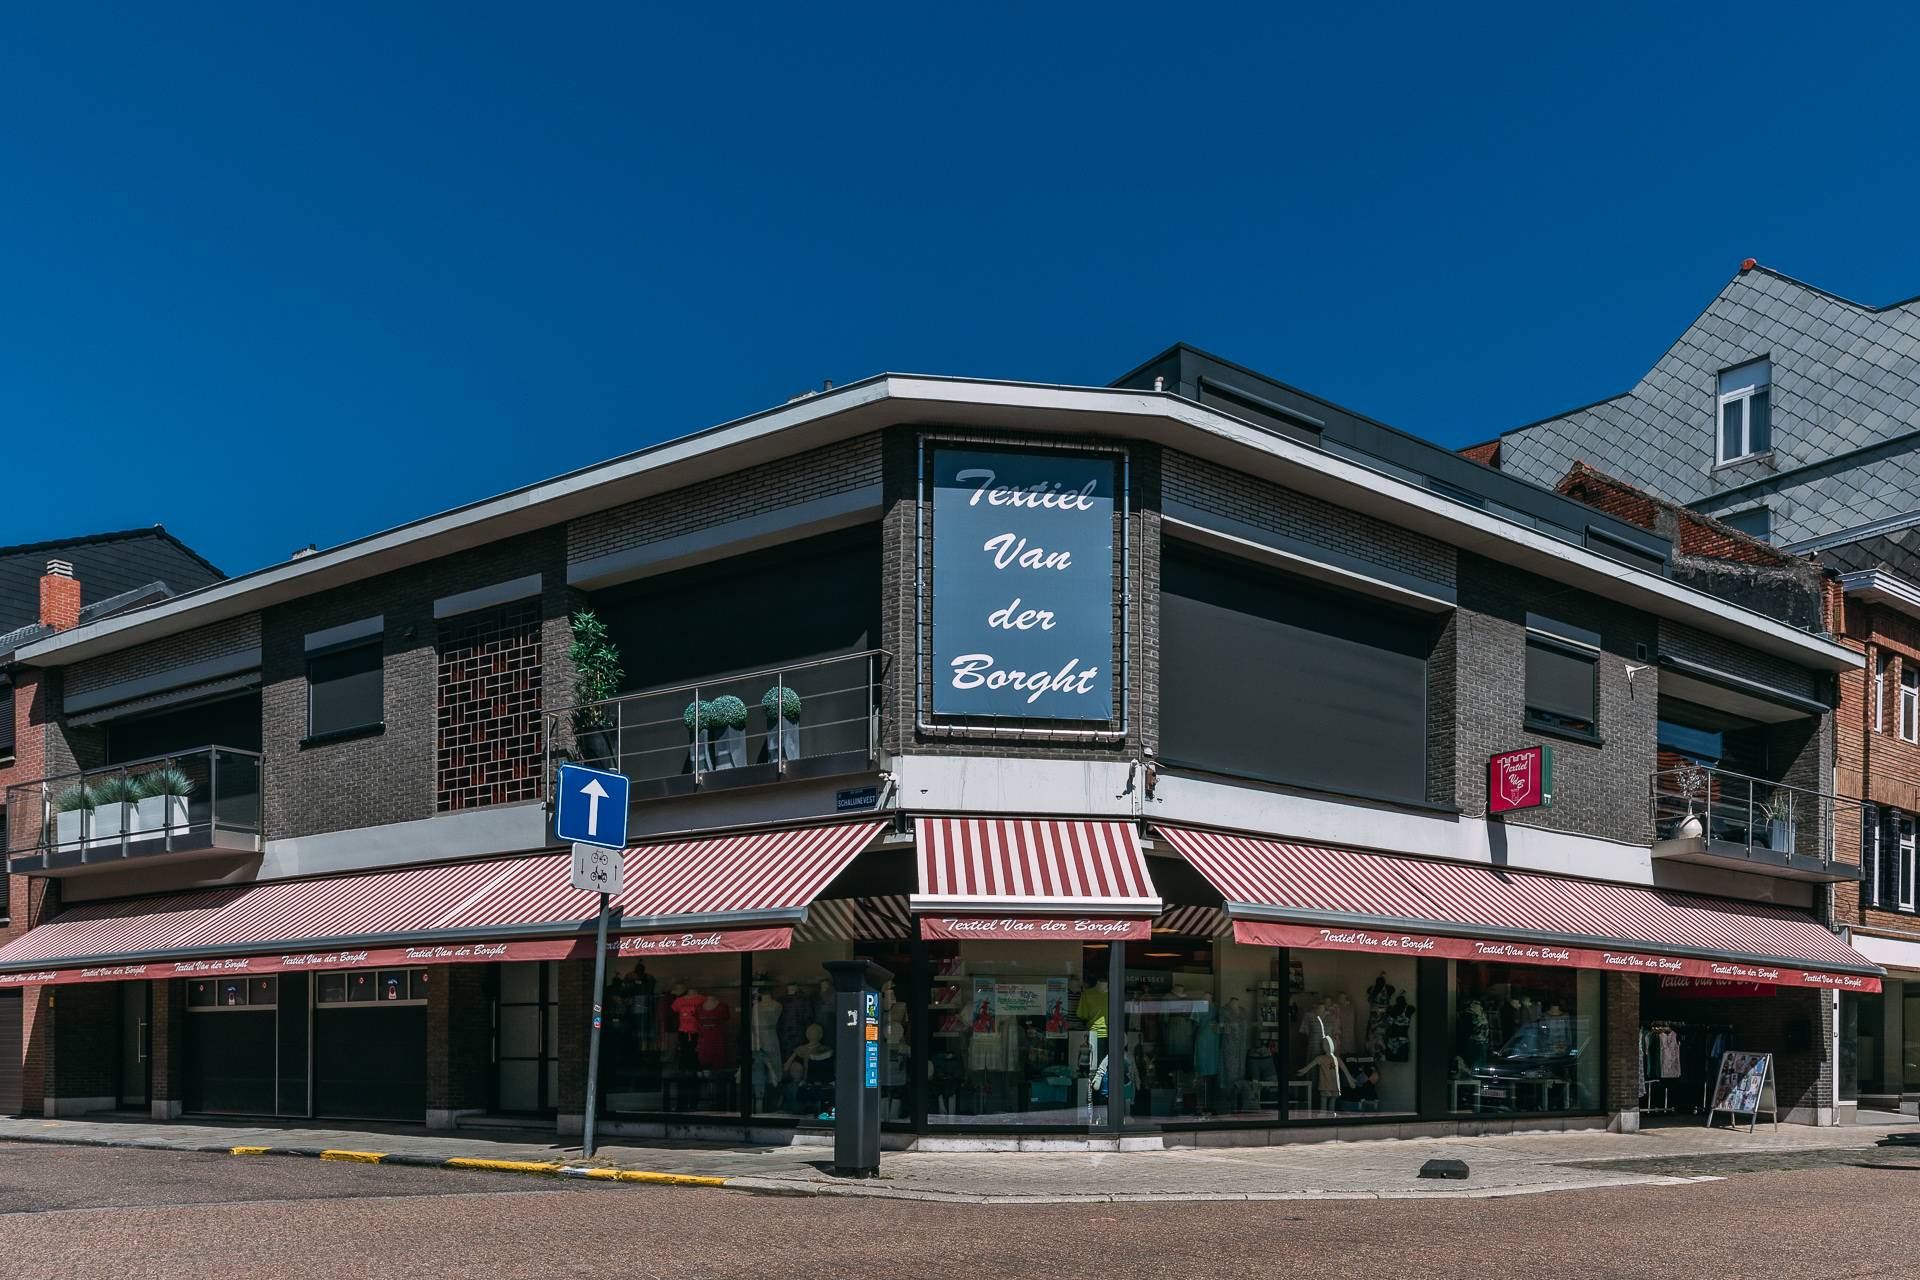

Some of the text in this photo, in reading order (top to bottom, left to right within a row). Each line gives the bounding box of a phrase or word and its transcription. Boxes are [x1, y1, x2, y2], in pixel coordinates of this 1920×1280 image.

[955, 468, 1097, 511] Textiel
[983, 532, 1072, 571] Van
[987, 598, 1056, 630] der
[950, 653, 1098, 704] Borght
[1504, 761, 1528, 773] Textiel
[942, 919, 1131, 935] Textiel Van der Borght
[597, 933, 722, 950] xtiel Van der Borght
[1320, 930, 1435, 952] Textiel Van der Borght
[282, 951, 368, 965] Textiel Van der Borght
[406, 943, 507, 959] Textiel Van der Borght
[1475, 943, 1569, 962] Textiel Van der Borght
[174, 958, 249, 972] Textiel Van der Borght
[1603, 953, 1682, 971] Textiel Van der Borght
[81, 965, 147, 978] Textiel Van der Borght
[1711, 963, 1779, 980] Textiel Van der Borght
[1803, 972, 1862, 988] Textiel Van der Borght
